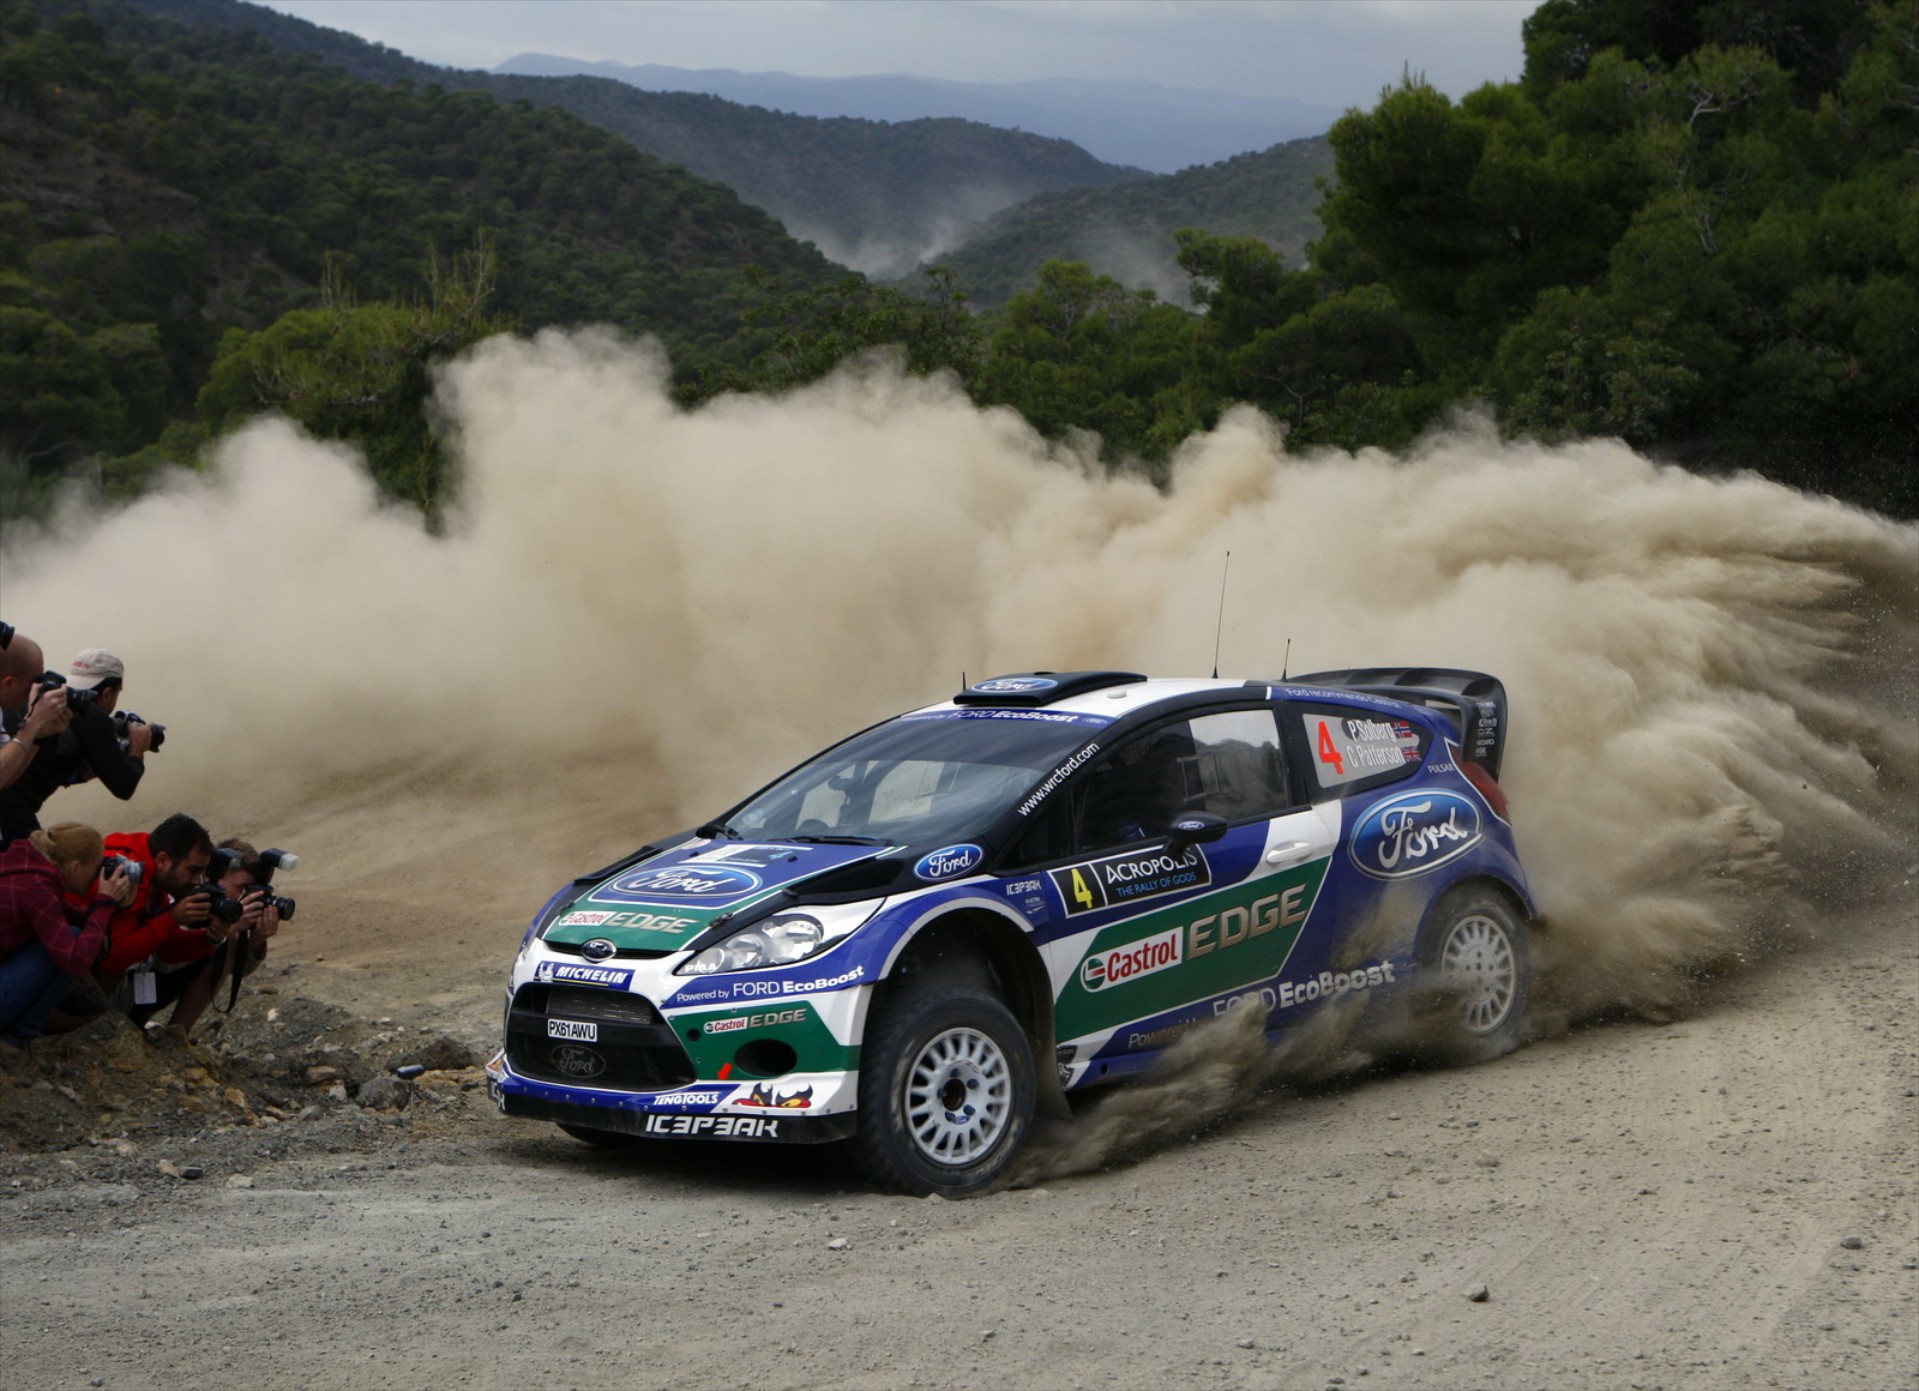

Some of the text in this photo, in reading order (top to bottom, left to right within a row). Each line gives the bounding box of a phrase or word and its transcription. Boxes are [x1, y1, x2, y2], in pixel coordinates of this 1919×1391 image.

[1285, 688, 1309, 697] Ford
[993, 710, 1079, 723] EcoBoost
[1347, 719, 1396, 742] P Solberg
[1318, 721, 1344, 774] 4
[1347, 745, 1406, 767] C Patterson
[1017, 742, 1099, 817] www.wrcford.com
[1427, 764, 1455, 773] PULSAR
[1379, 801, 1468, 869] Ford
[929, 849, 973, 878] Ford
[628, 865, 736, 892] Ford
[1071, 868, 1093, 909] 4
[1116, 872, 1197, 897] THE RALLY OF GODS
[569, 912, 700, 934] Castrol EDGE
[1107, 883, 1307, 983] Castrol EDGE
[556, 966, 628, 983] MICHELIN
[685, 962, 717, 973] PIAA
[677, 965, 864, 1002] Powered by FORD EcoBoost
[1128, 1020, 1185, 1049] Powere
[1279, 960, 1395, 1008] EcoBoost
[550, 1020, 596, 1039] PX61AWU
[714, 1008, 807, 1032] Castrol EDGE
